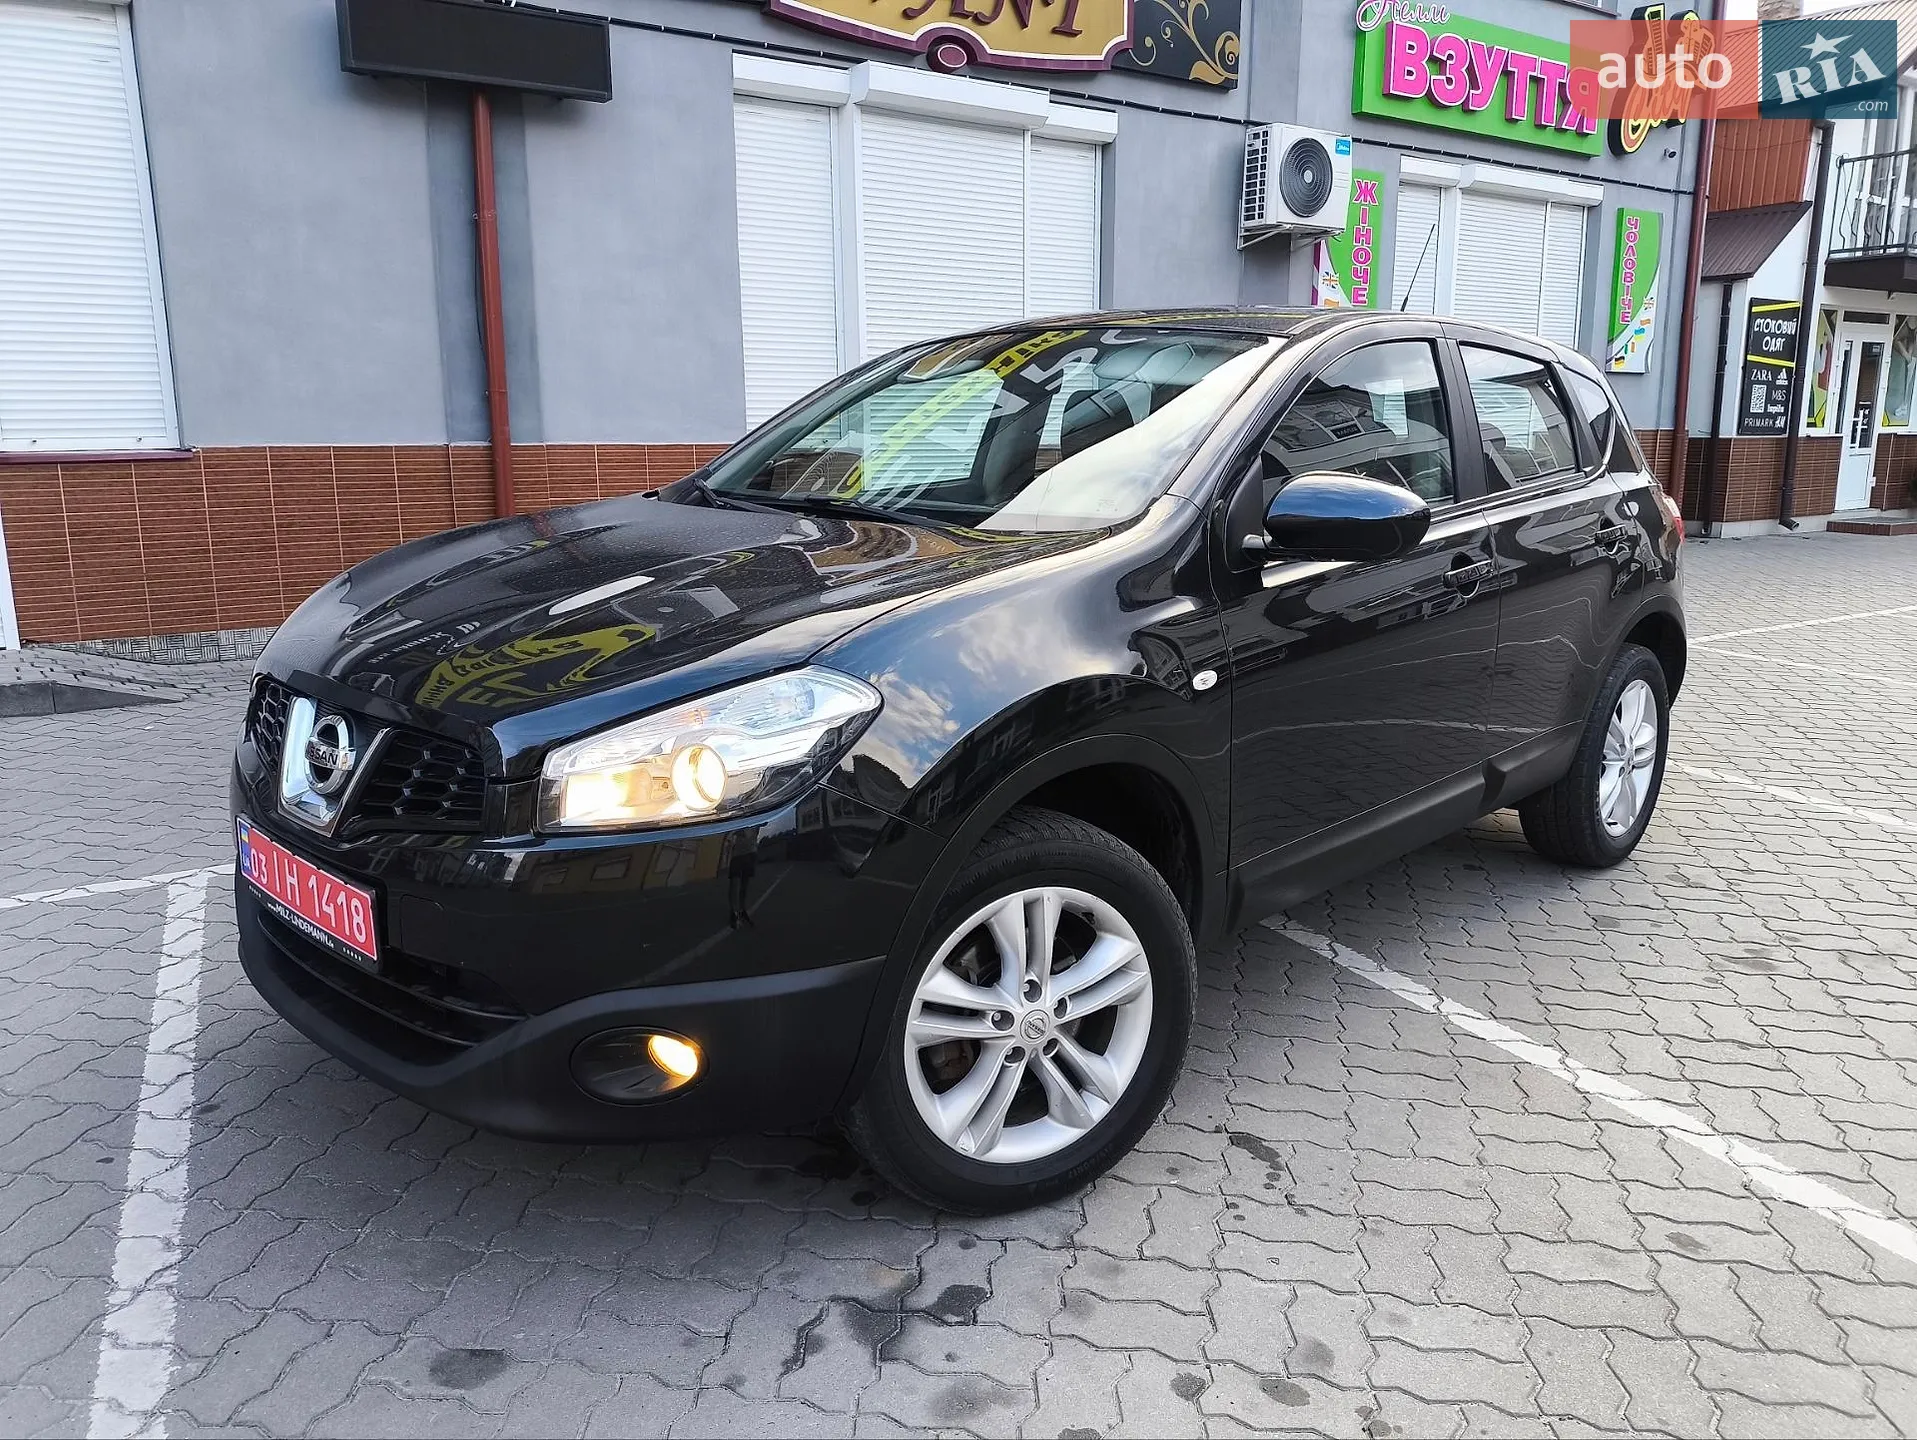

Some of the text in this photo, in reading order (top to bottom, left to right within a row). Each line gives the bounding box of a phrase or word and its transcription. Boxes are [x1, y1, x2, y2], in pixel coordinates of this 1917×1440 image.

[1383, 22, 1599, 135] ВЗУТТЯ
[1352, 178, 1379, 306] ЖІНОЧЕ
[1619, 216, 1640, 325] ЧОЛОВІЧЕ
[1754, 318, 1797, 336] СТОКОВИЙ
[1762, 336, 1786, 353] ОДЯГ
[1750, 368, 1773, 381] ZARA
[1744, 417, 1774, 428] PRIMARK
[250, 847, 268, 885] 03
[308, 874, 366, 944] 1418
